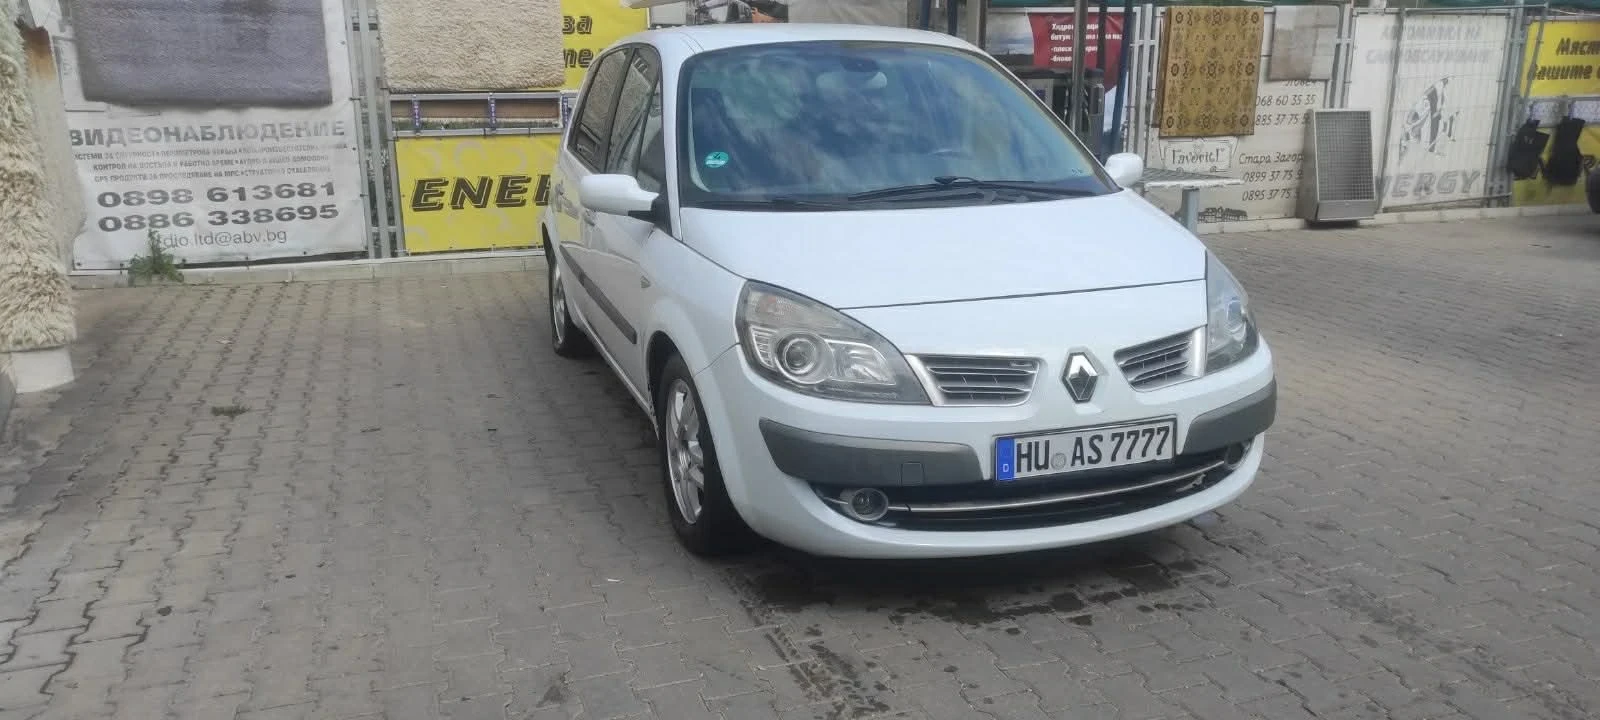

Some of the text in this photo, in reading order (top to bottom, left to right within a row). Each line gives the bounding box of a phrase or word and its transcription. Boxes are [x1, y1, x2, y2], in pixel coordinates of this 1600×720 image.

[69, 120, 345, 147] ВИДЕОНАБЛЮДЕНИЕ
[97, 182, 336, 208] 0898 613681
[98, 204, 339, 232] 0886 338695
[1016, 425, 1170, 473] HU AS 7777
[1002, 463, 1010, 473] D
